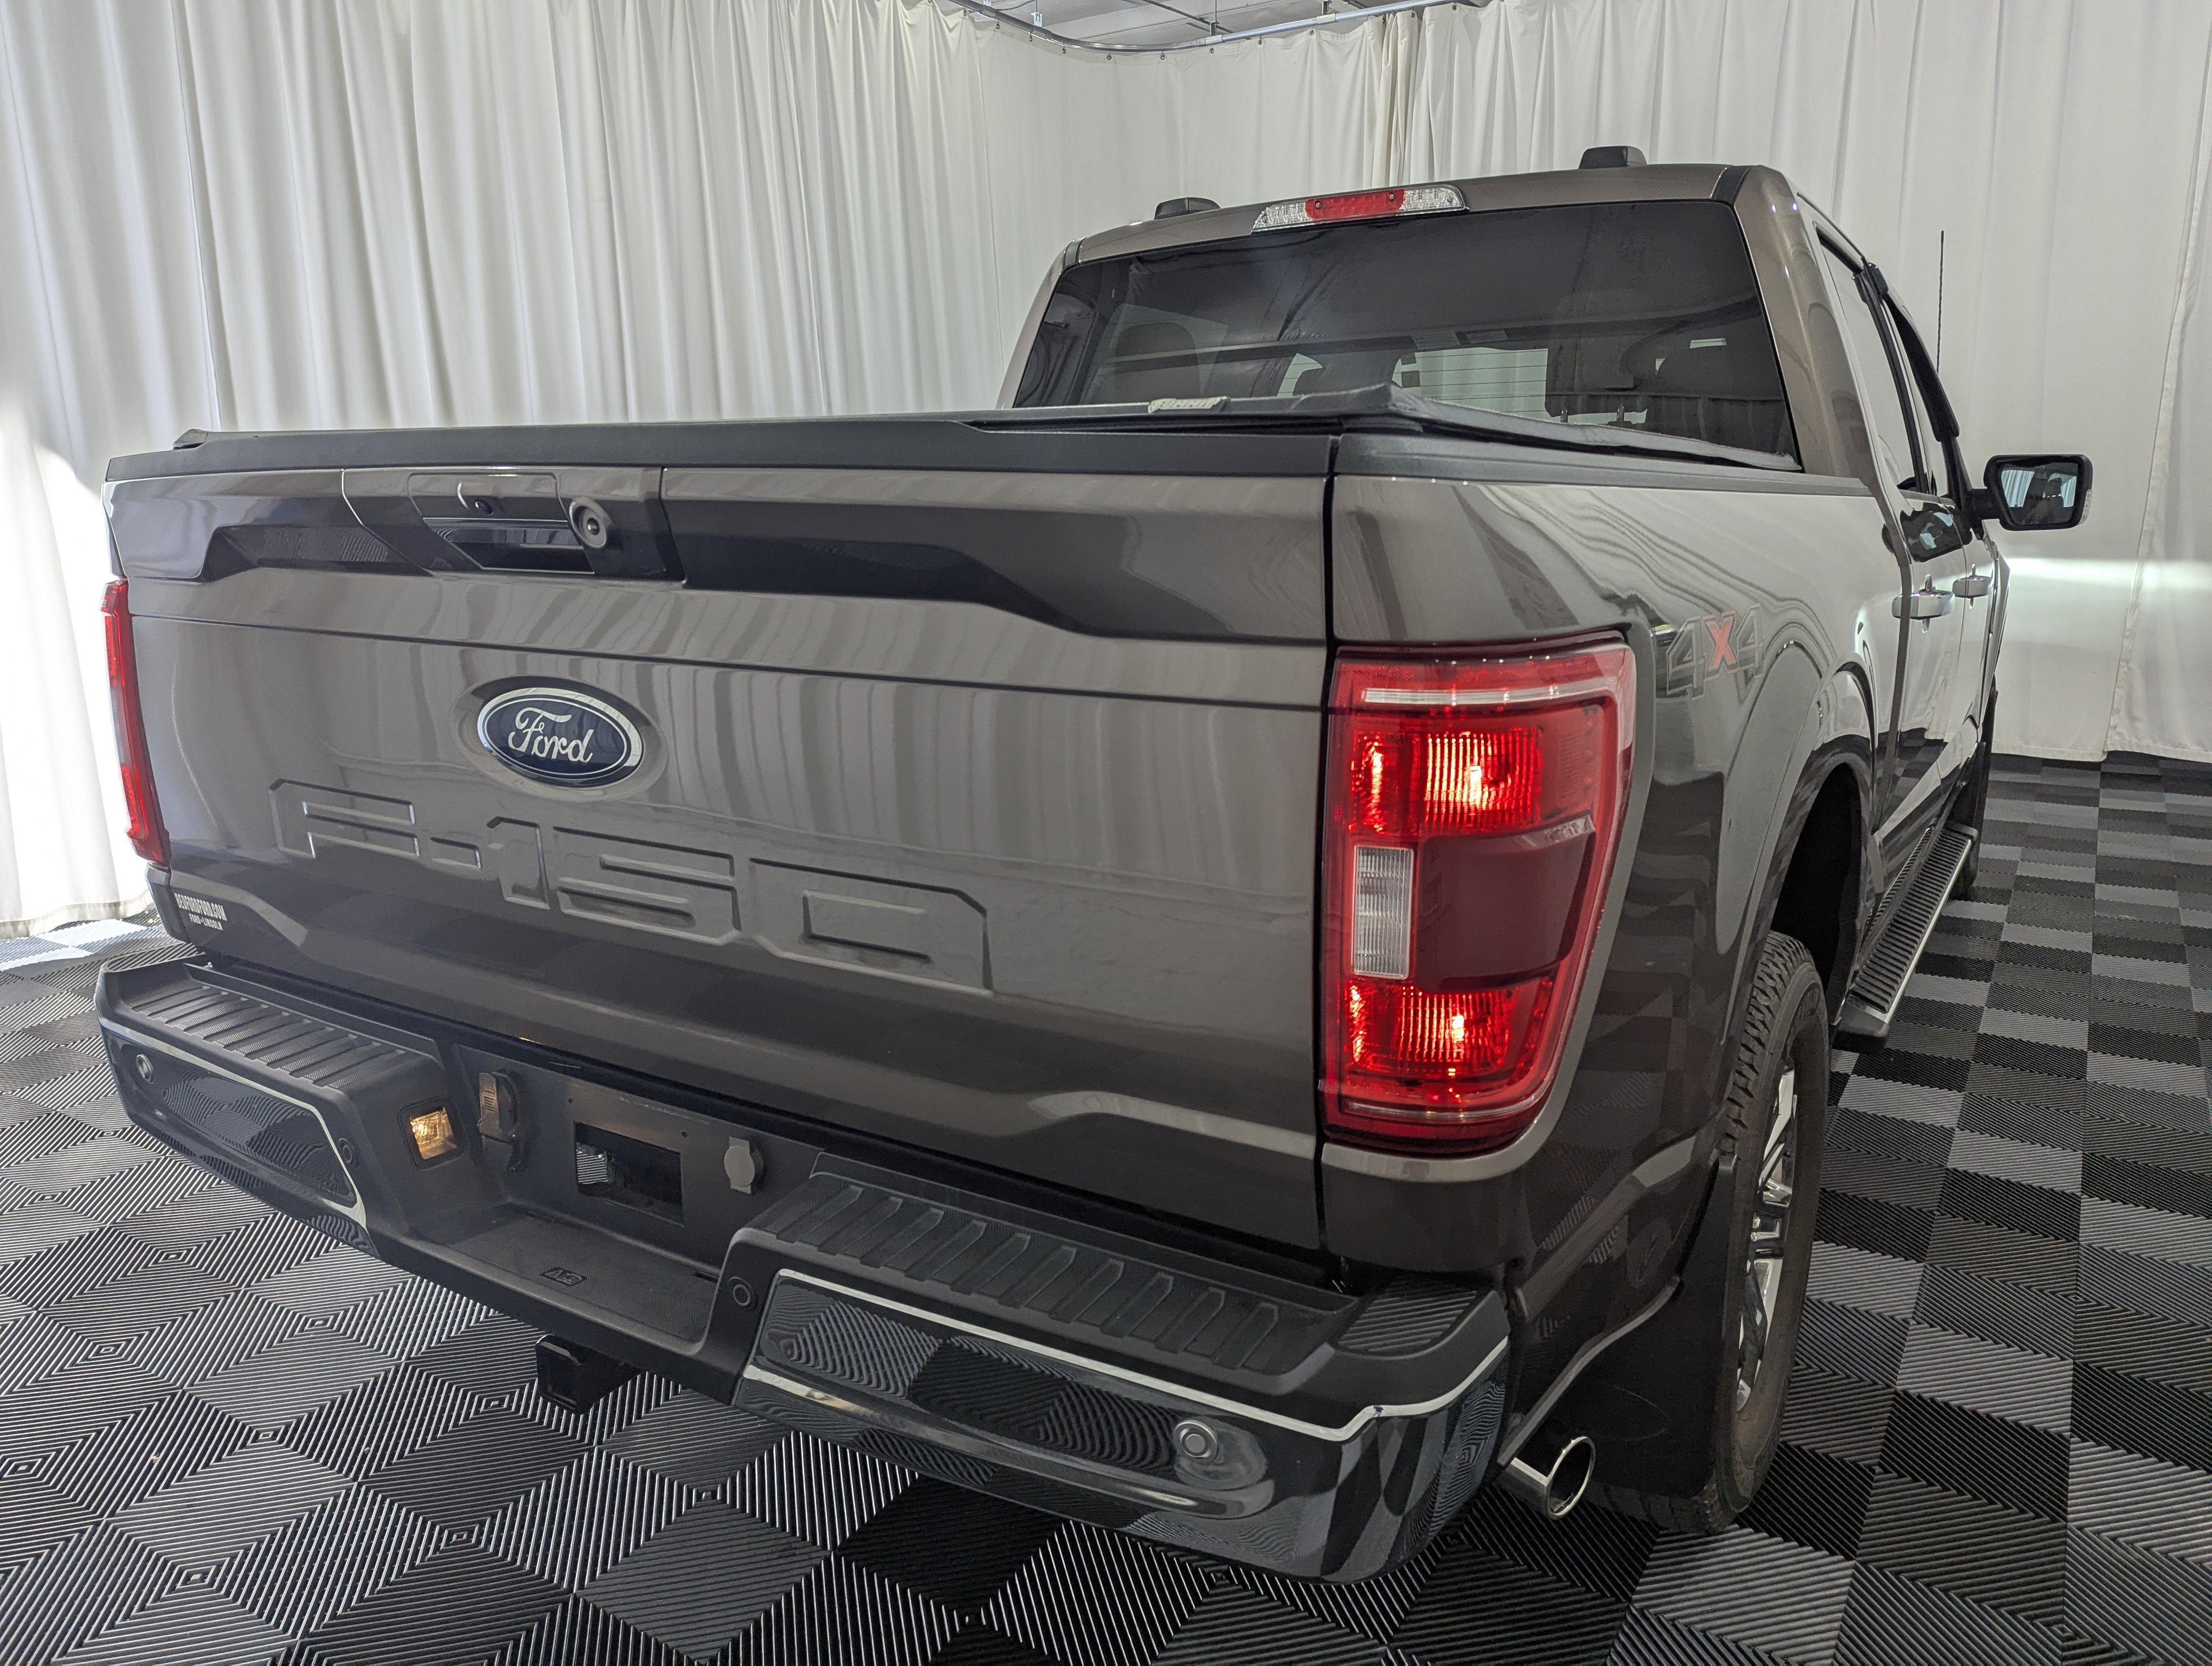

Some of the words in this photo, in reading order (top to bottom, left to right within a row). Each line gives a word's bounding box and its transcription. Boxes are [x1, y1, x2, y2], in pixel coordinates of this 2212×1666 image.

[508, 707, 594, 763] Ford
[174, 893, 228, 921] BEDFORDFORD.COM
[269, 778, 994, 998] F-150
